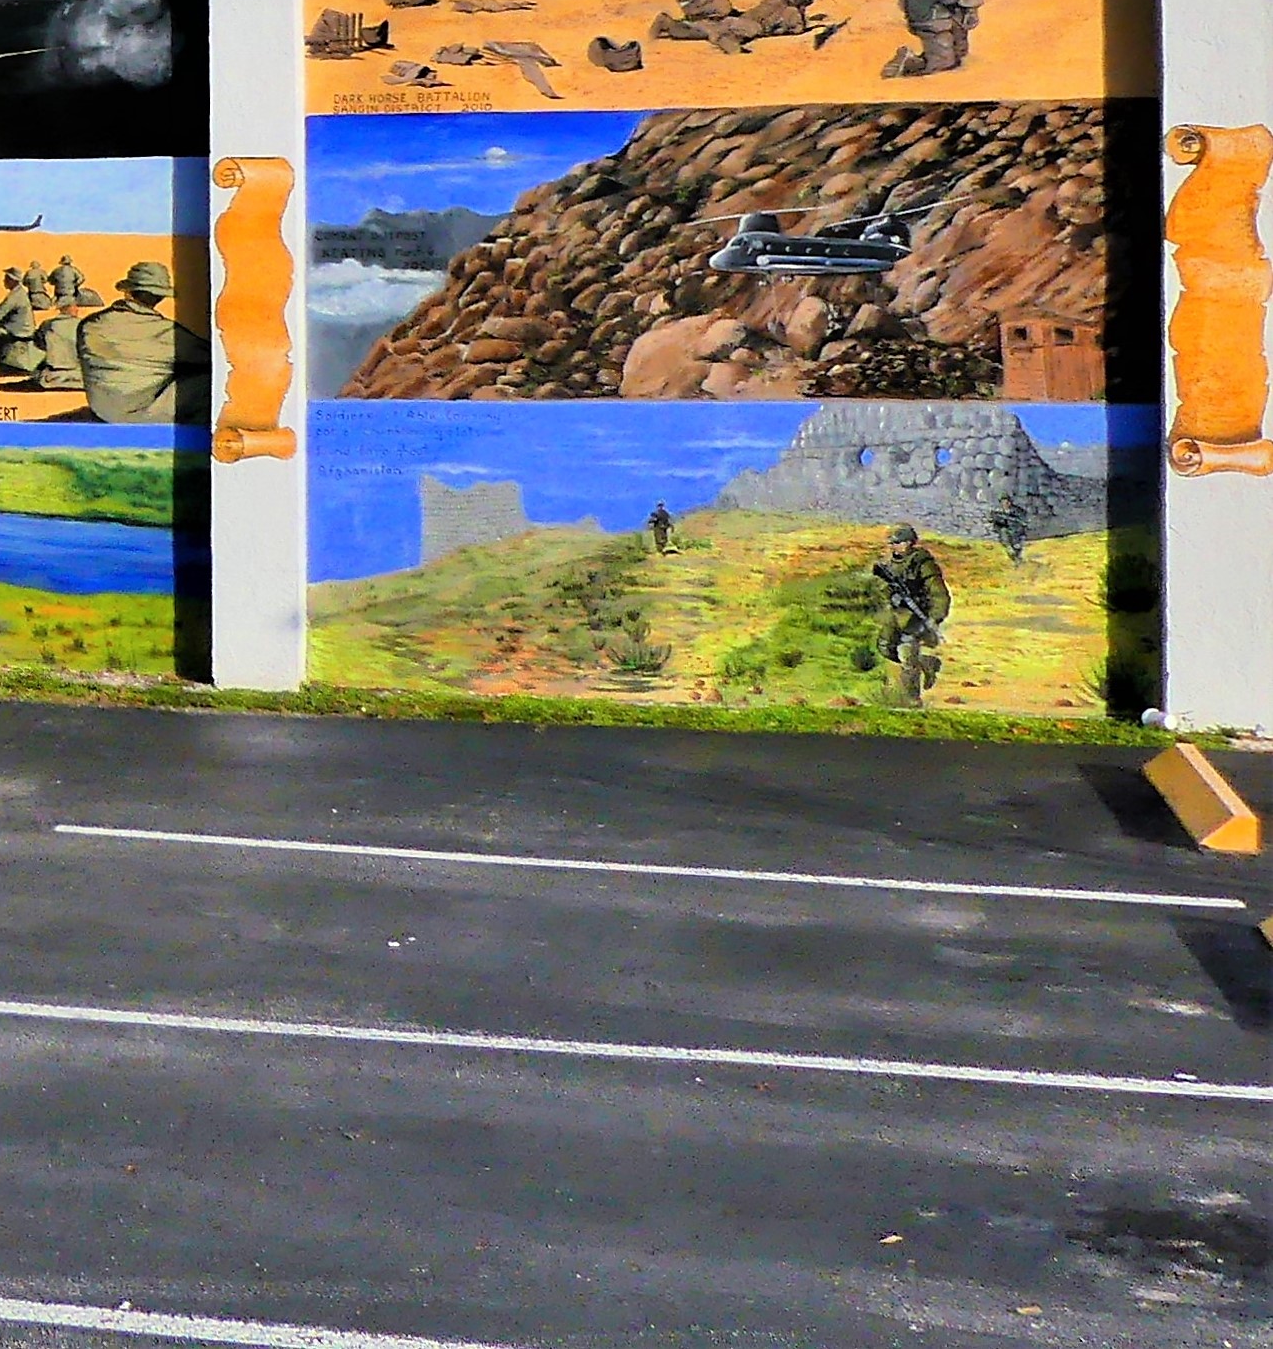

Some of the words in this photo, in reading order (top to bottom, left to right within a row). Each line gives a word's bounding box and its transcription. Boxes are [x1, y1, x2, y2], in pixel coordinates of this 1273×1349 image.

[333, 93, 364, 105] DARK
[368, 92, 407, 104] HORSE
[416, 91, 491, 102] BATTALION
[383, 102, 442, 114] DISTRICT
[461, 102, 494, 112] 2010
